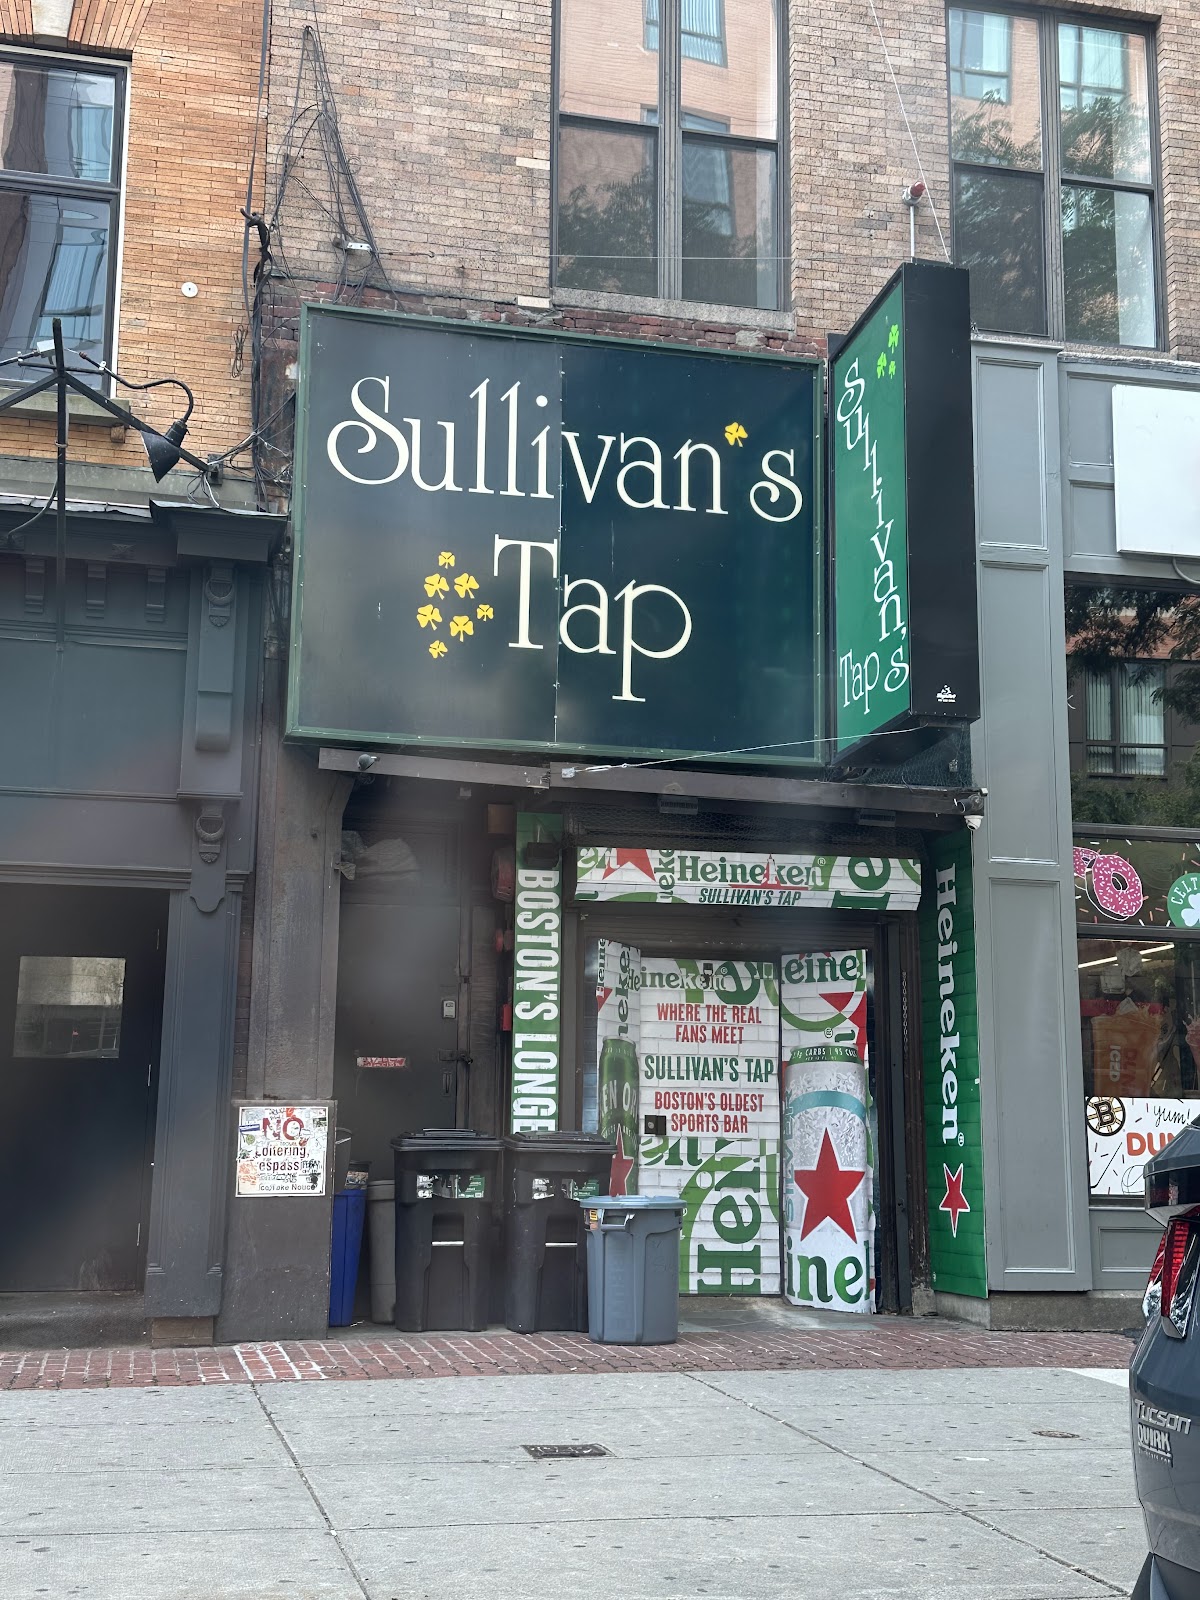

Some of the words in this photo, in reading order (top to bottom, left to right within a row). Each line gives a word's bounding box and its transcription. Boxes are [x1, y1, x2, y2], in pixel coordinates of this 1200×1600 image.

[493, 533, 693, 703] Tap
[839, 648, 881, 715] Tap
[677, 855, 824, 887] Heineken
[698, 888, 774, 906] SULLIVAN'S
[776, 891, 802, 906] TAP
[1170, 876, 1198, 905] CELT
[514, 869, 560, 1021] BOSTON'S
[657, 1003, 701, 1022] WHERE
[706, 1004, 728, 1023] THE
[732, 1006, 762, 1024] REAL
[935, 862, 961, 1145] Heineken
[675, 1024, 707, 1043] FANS
[711, 1026, 744, 1044] MEET
[644, 1055, 739, 1082] SULLIVAN'S
[745, 1059, 774, 1083] TAP
[654, 1091, 716, 1111] BOSTON'S
[720, 1093, 764, 1112] OLDEST
[262, 1116, 304, 1141] NO
[671, 1112, 719, 1133] SPORTS
[723, 1115, 748, 1134] BAR
[1153, 1105, 1191, 1128] yum!
[1135, 1398, 1192, 1435] TUCSON
[1137, 1423, 1172, 1452] QUIRK
